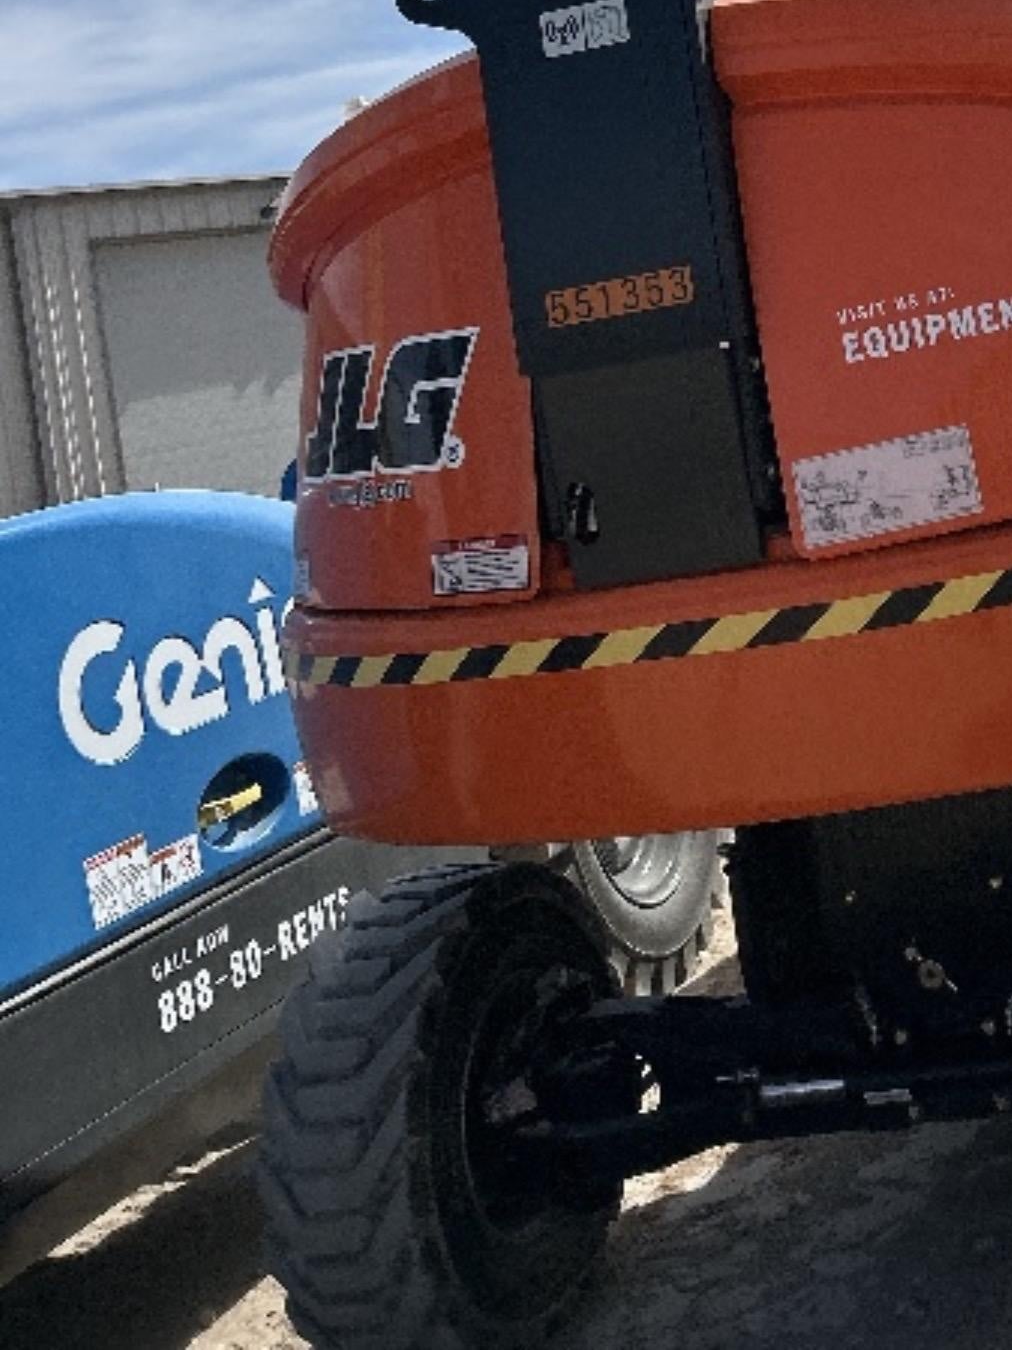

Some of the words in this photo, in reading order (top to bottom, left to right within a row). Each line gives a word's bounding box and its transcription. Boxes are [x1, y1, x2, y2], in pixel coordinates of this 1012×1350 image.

[550, 268, 690, 325] 551353
[837, 299, 886, 324] VISIT
[58, 575, 295, 767] Geni
[151, 947, 193, 982] CALL
[157, 885, 350, 1033] 888-80-RENTS
